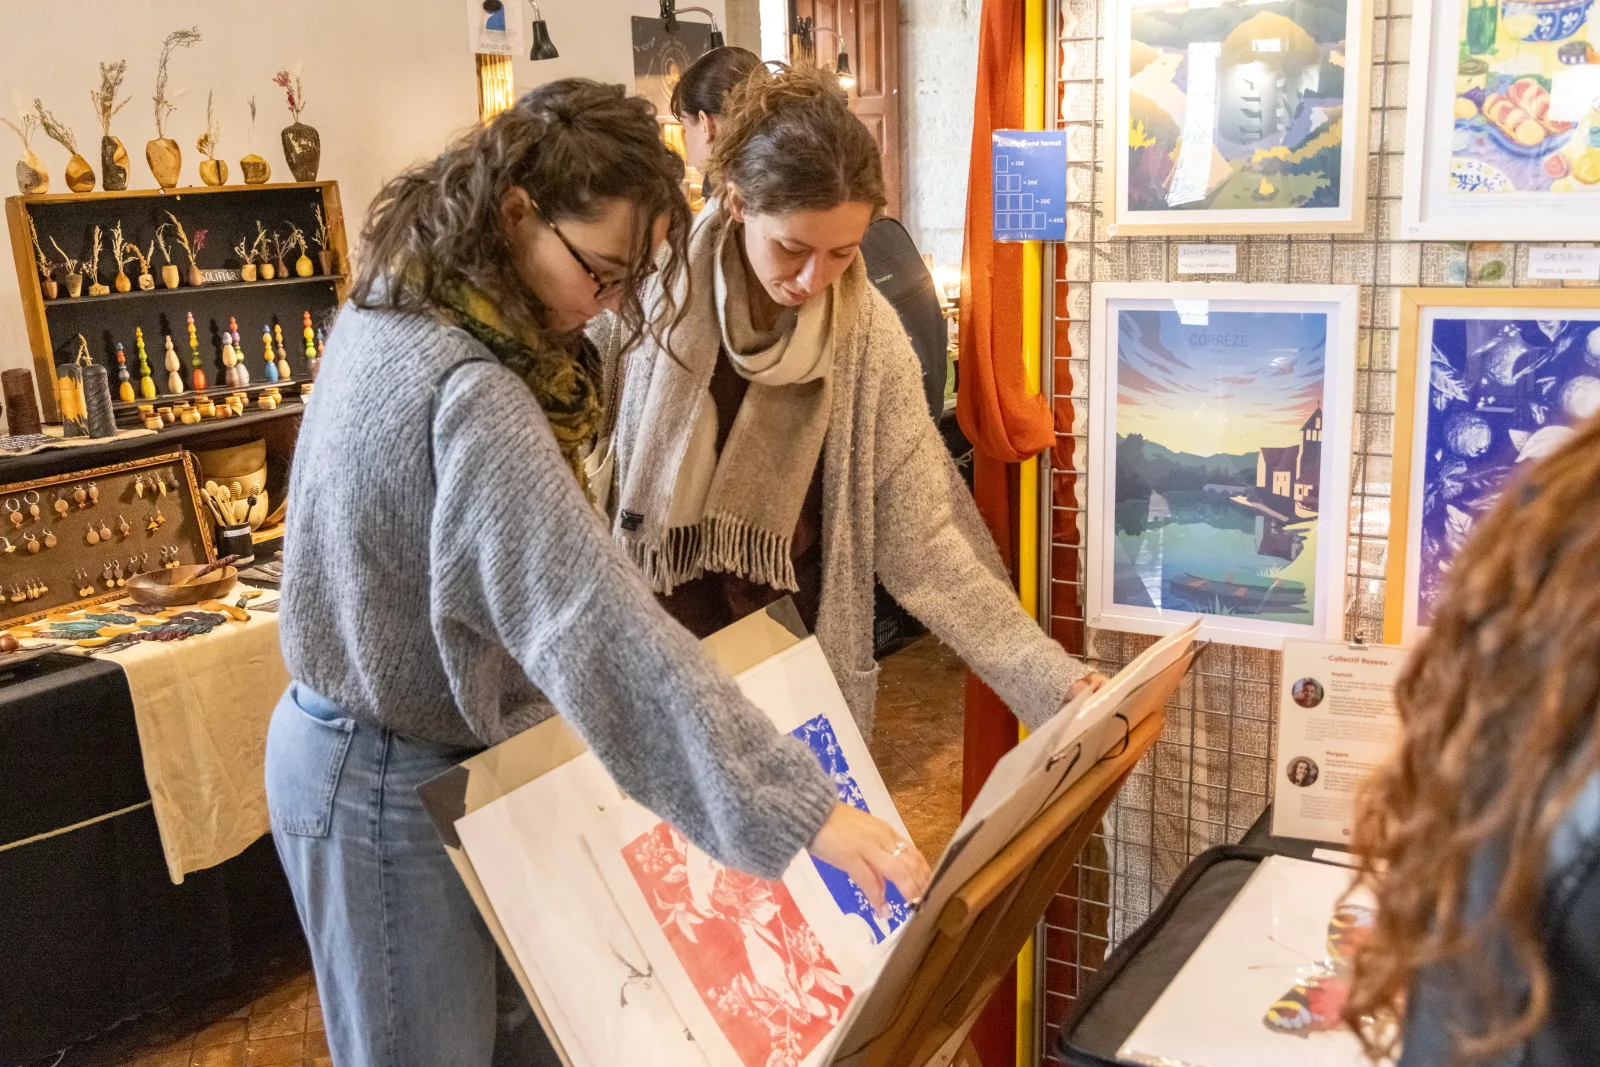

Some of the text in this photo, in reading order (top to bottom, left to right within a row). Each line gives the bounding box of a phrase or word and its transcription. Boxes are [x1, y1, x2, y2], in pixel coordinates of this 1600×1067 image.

[1182, 248, 1230, 256] ILLUSTRATION
[1544, 252, 1583, 261] DESSIN
[1189, 333, 1249, 348] CORRÈZE
[1328, 655, 1360, 663] Collectif
